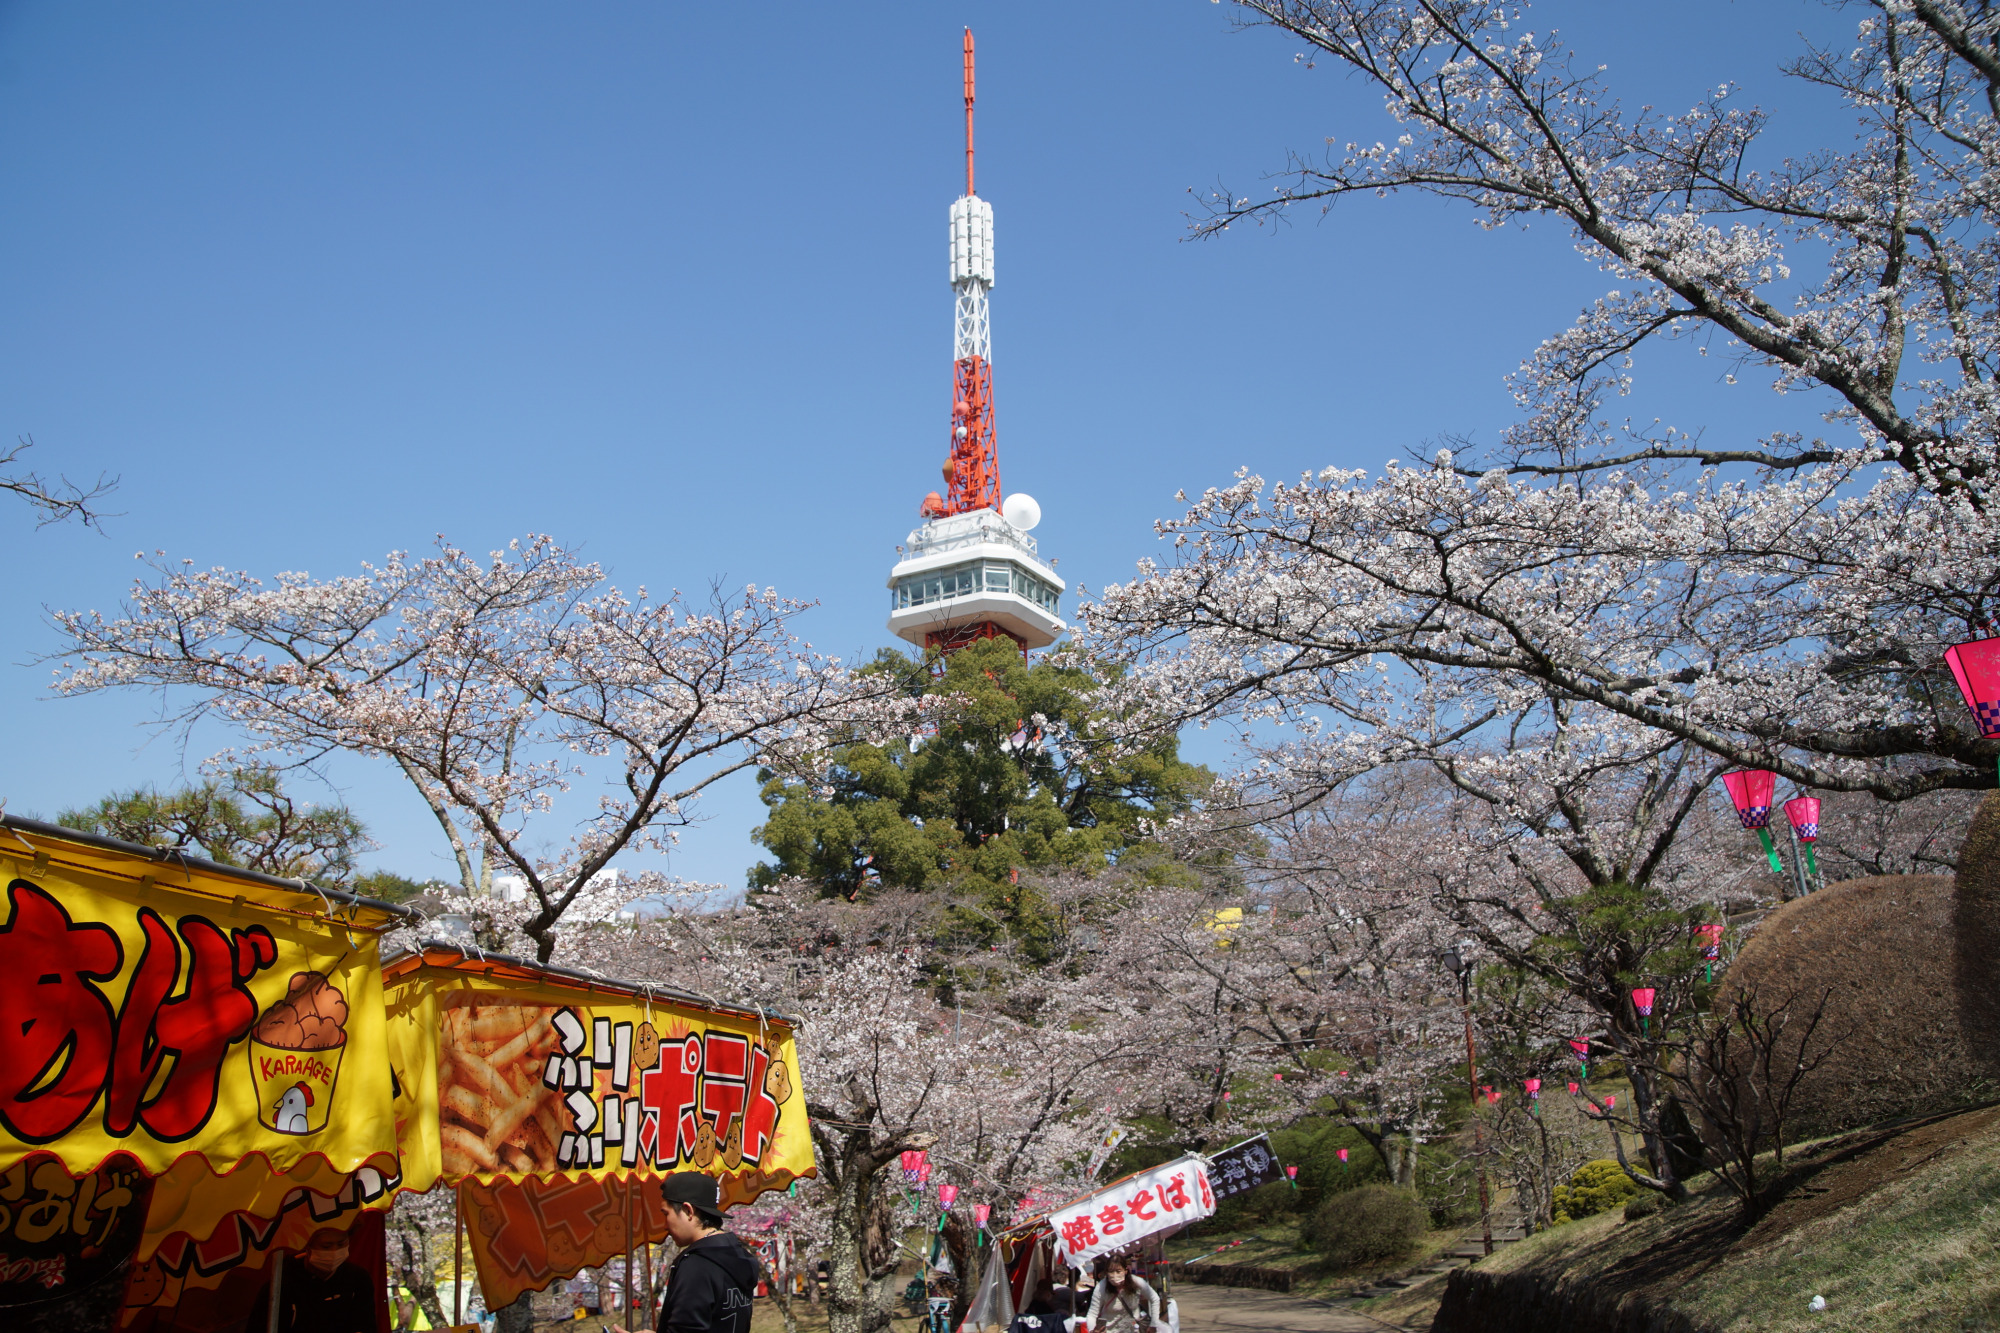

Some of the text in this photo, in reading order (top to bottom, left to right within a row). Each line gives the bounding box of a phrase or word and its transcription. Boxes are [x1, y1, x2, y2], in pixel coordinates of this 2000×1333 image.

[259, 1054, 333, 1086] KARAAGE
[543, 1006, 633, 1093] ふり
[557, 1089, 640, 1170] ふり
[639, 1029, 782, 1171] ポテト
[1061, 1171, 1191, 1256] 焼きそば
